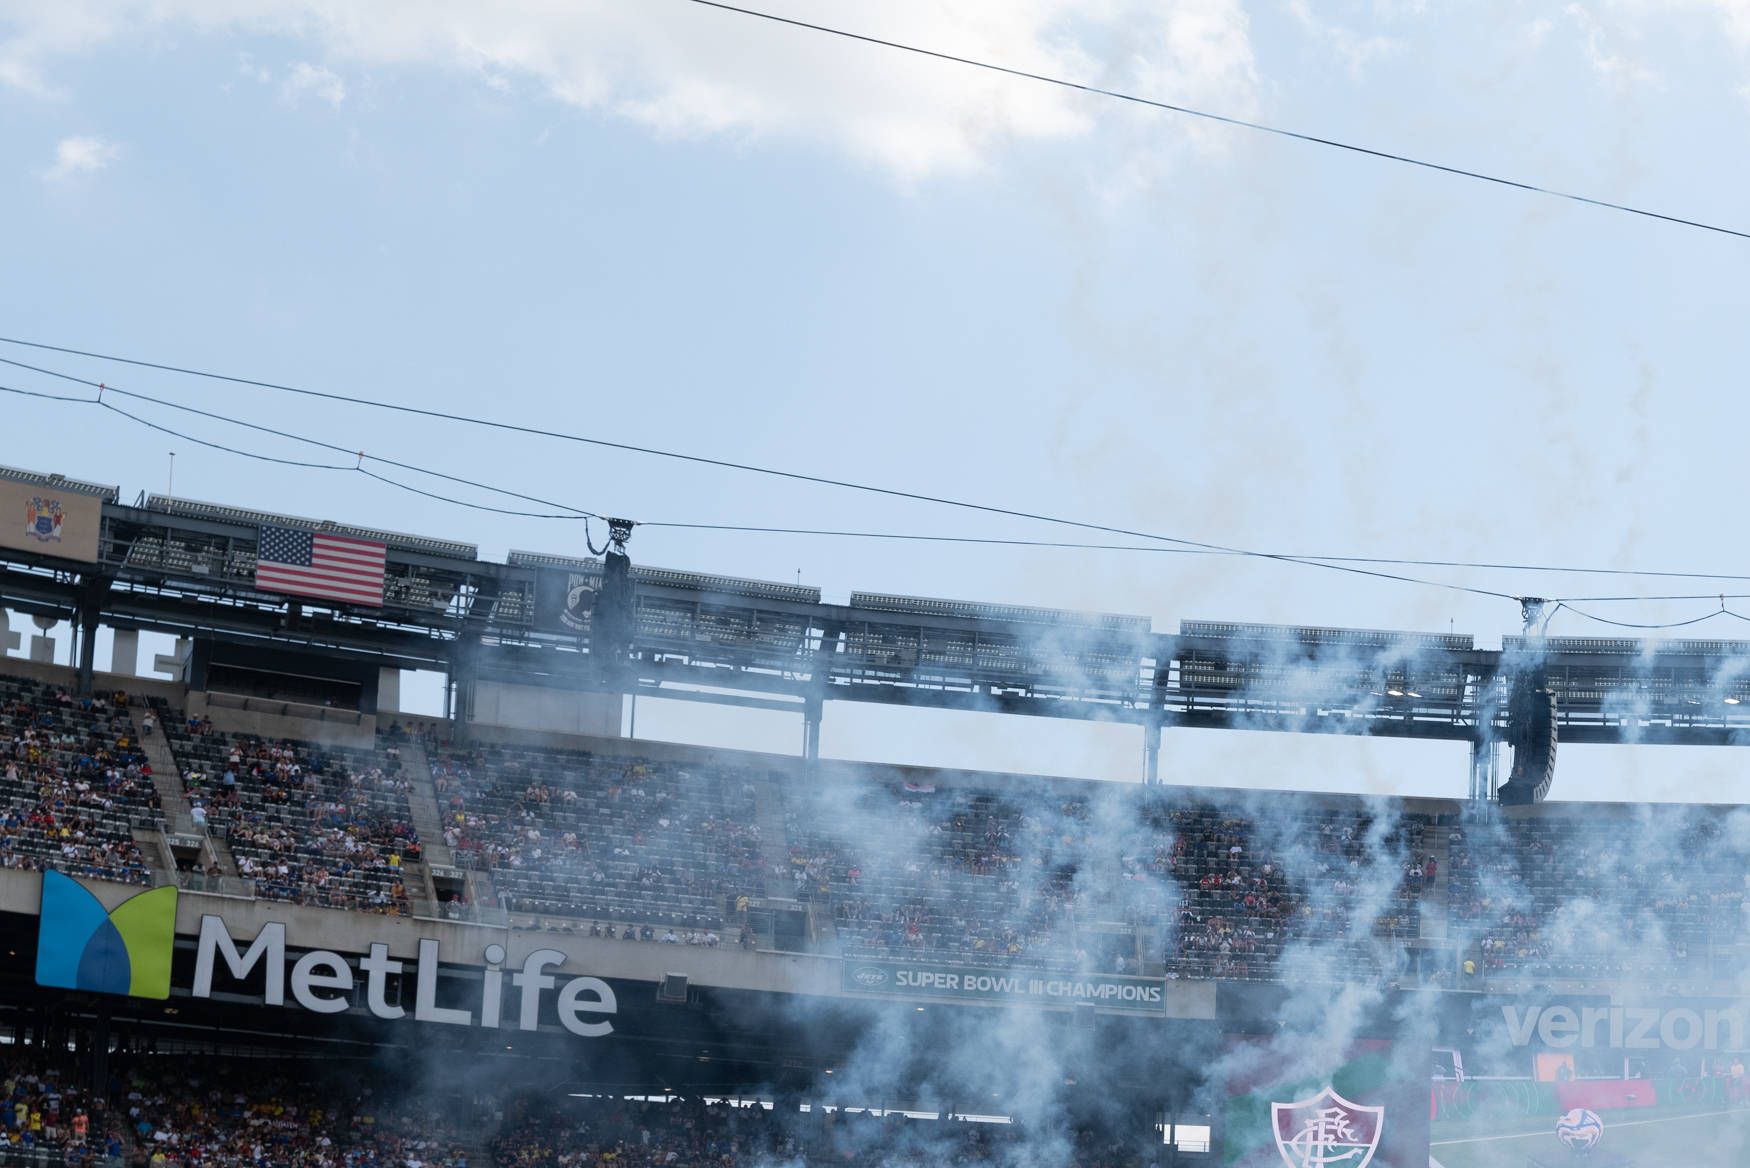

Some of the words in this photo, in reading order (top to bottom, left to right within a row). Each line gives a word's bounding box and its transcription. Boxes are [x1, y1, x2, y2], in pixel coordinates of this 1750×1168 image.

[192, 913, 618, 1038] MetLife
[895, 970, 959, 990] SUPER
[963, 976, 1025, 995] BOWL
[1029, 979, 1044, 995] III
[1046, 980, 1162, 1003] CHAMPIONS
[1501, 997, 1747, 1051] verizon
